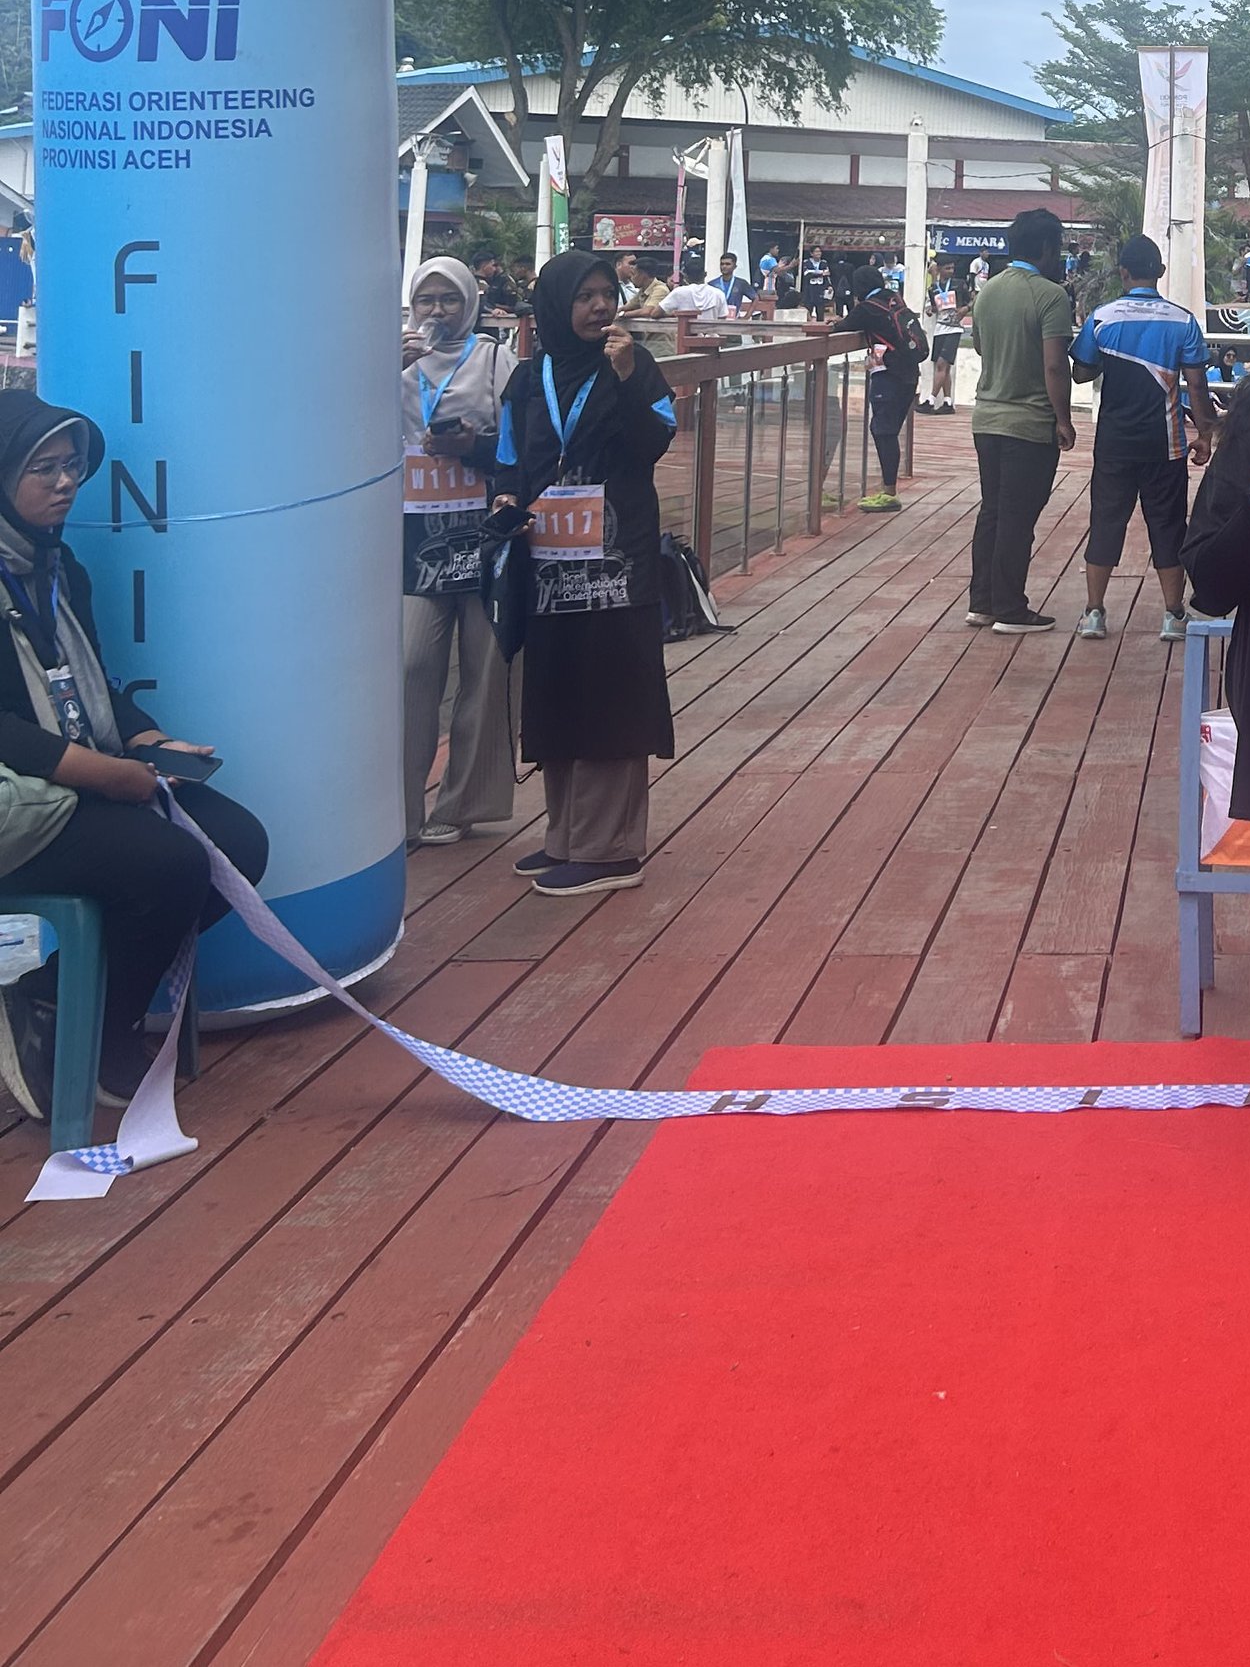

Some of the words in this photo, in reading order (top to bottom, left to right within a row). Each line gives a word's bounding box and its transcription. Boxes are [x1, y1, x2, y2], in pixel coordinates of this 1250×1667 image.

[41, 90, 121, 112] FEDERASI
[129, 88, 316, 111] ORIENTEERING
[42, 120, 126, 141] NASIONAL
[134, 118, 273, 140] INDONESIA
[42, 148, 116, 170] PROVINSI
[123, 149, 191, 170] ACEH
